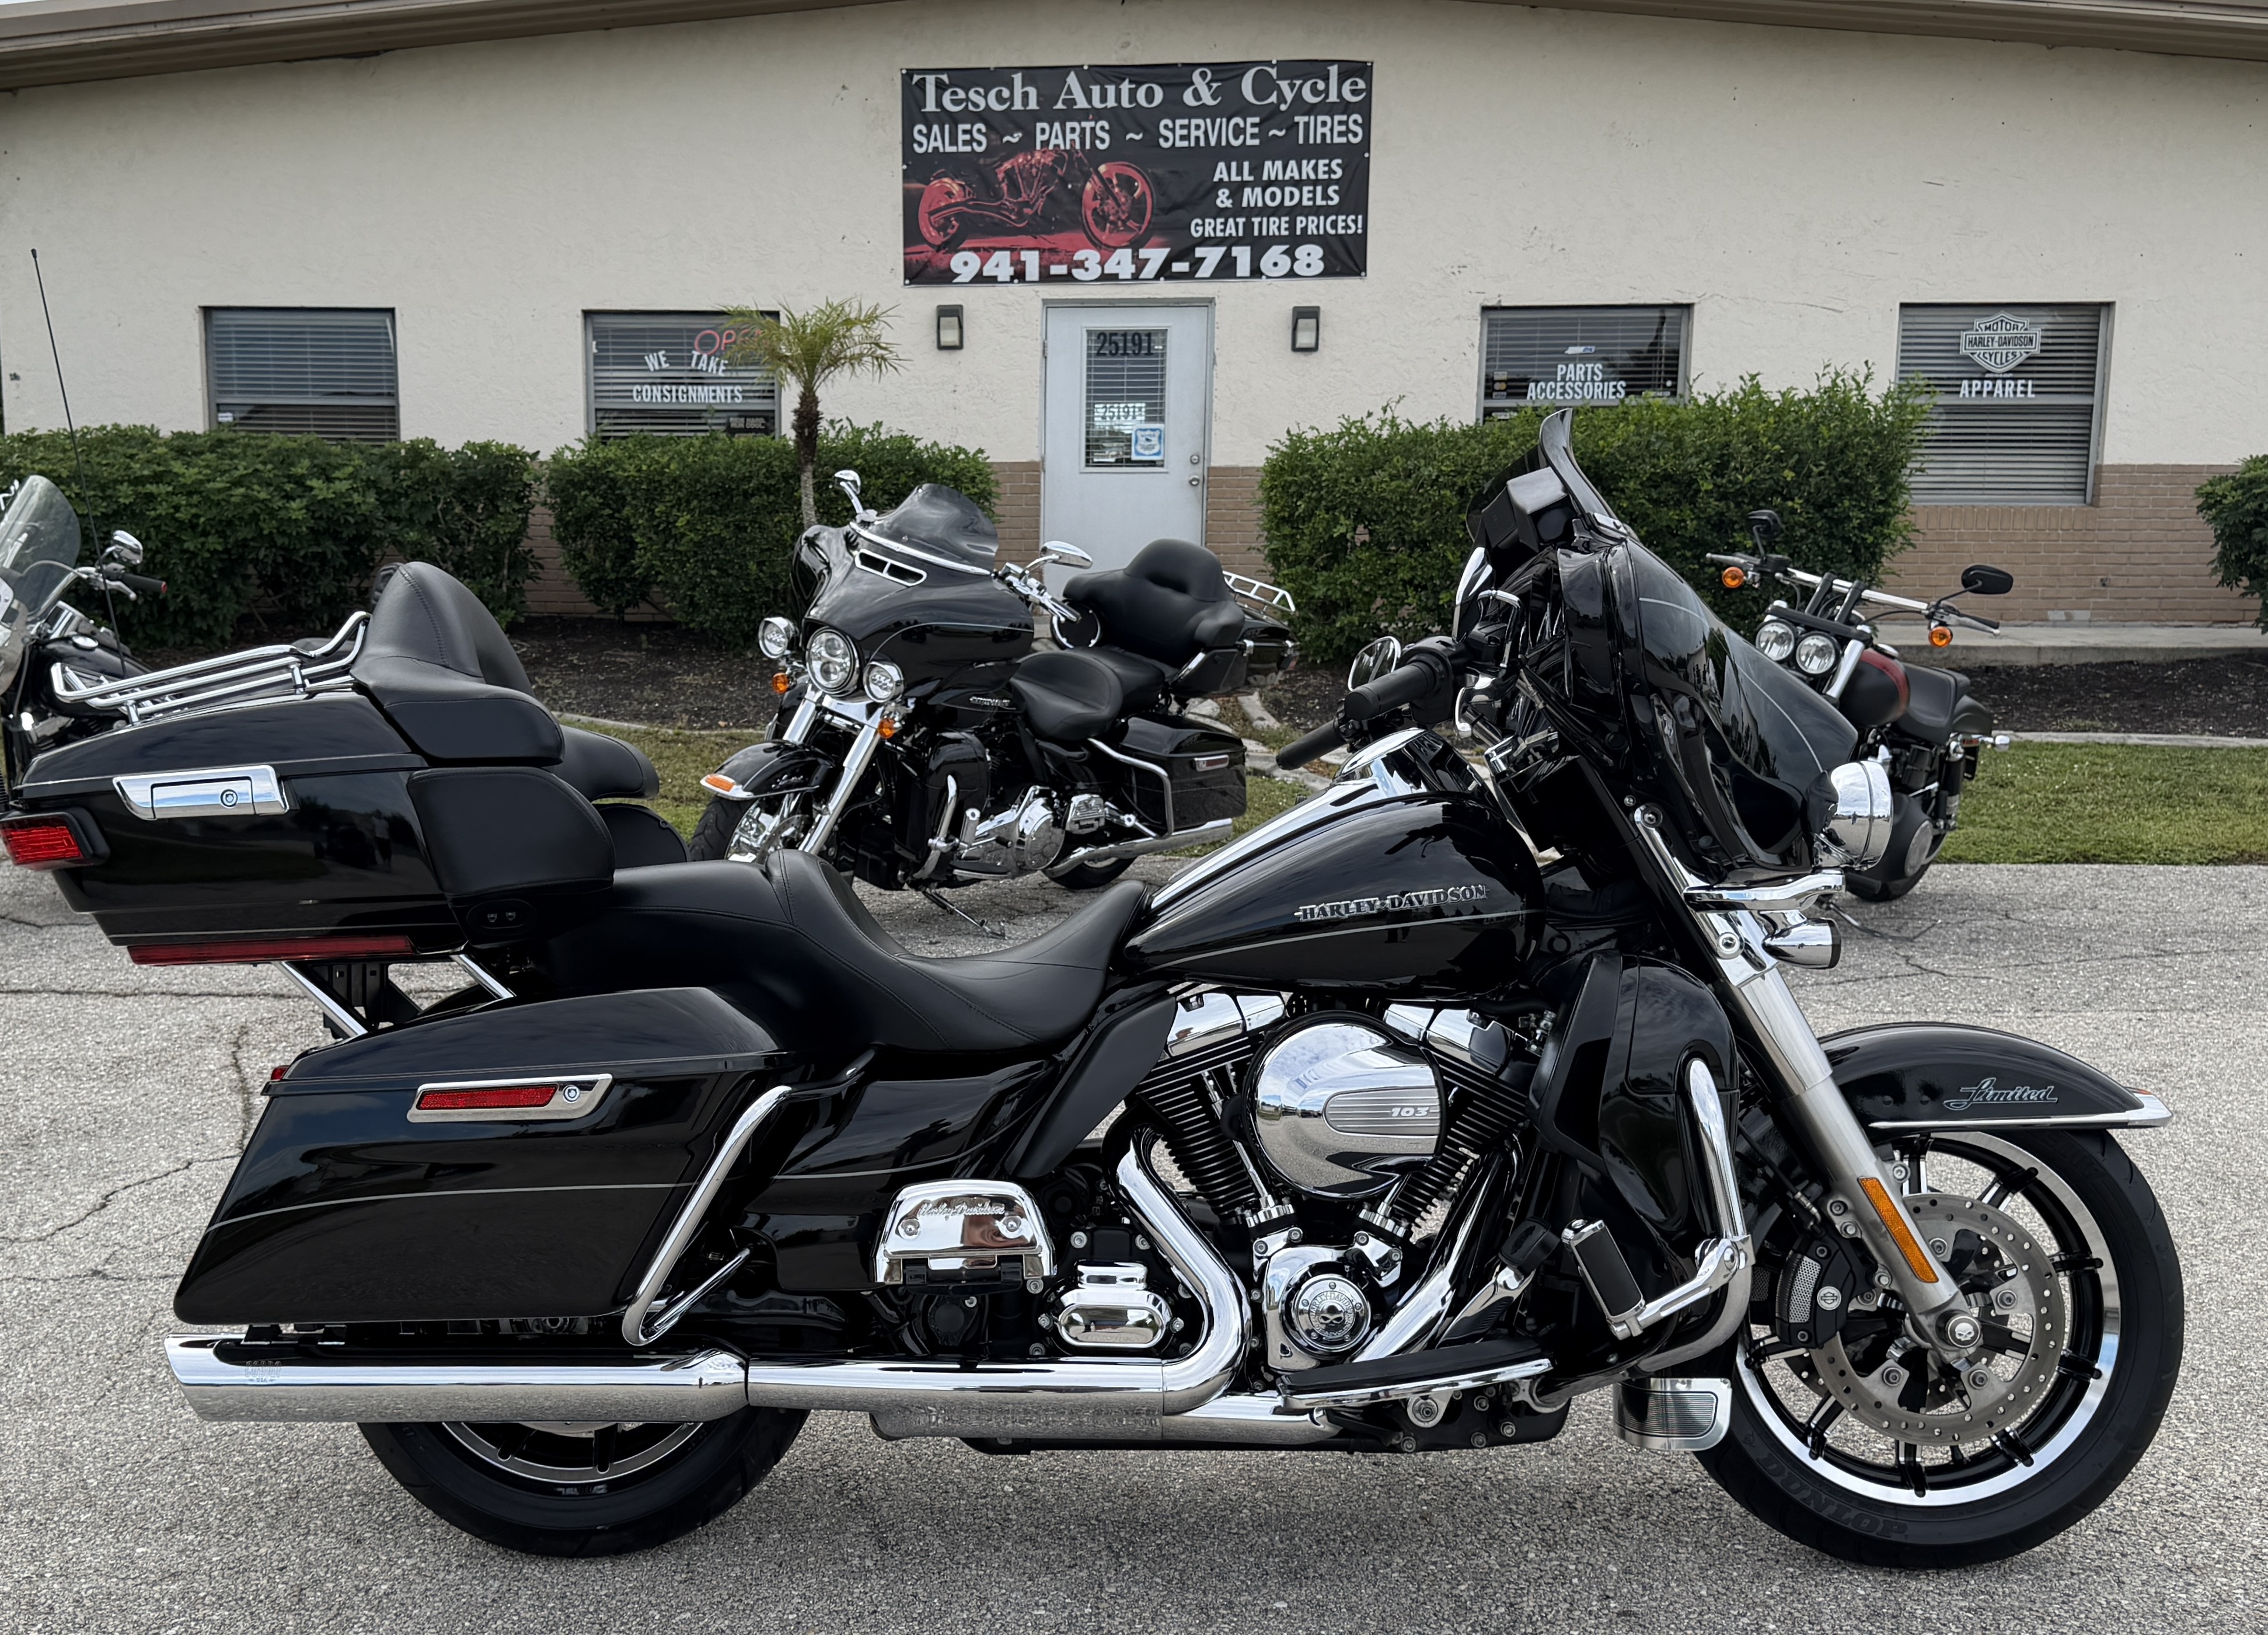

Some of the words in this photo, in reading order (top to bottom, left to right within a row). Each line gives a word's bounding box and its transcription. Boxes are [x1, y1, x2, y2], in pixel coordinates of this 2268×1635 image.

[912, 72, 1039, 112] Tesch
[1053, 75, 1164, 110] Auto
[1182, 67, 1222, 106] &
[1241, 66, 1367, 111] Cycle
[913, 123, 987, 154] SALES
[1035, 120, 1110, 150] PARTS
[1158, 117, 1260, 148] SERVICE
[1294, 114, 1363, 144] TIRES
[1213, 161, 1254, 182] ALL
[1262, 159, 1343, 180] MAKES
[1215, 189, 1233, 208] &
[1241, 186, 1340, 207] MODELS
[1190, 217, 1247, 238] GREAT
[1252, 216, 1289, 236] TIRE
[1296, 214, 1363, 235] PRICES!
[949, 244, 1325, 283] 941-347-7168
[1984, 319, 2019, 332] MOTOR
[1095, 332, 1154, 357] 25191
[1968, 336, 2034, 347] HARLEY-DAVIDSON
[644, 350, 669, 372] WE
[691, 350, 728, 376] TAKE
[1982, 351, 2017, 366] CYCLES
[1557, 363, 1603, 381] PARTS
[632, 385, 743, 403] CONSIGNMENTS
[1526, 381, 1627, 400] ACCESSORIES
[1959, 379, 2036, 398] APPAREL
[1101, 405, 1136, 420] 25191
[1943, 1077, 2058, 1110] Limited
[1390, 1107, 1429, 1117] 103
[1757, 1451, 1908, 1539] DUNLOP
